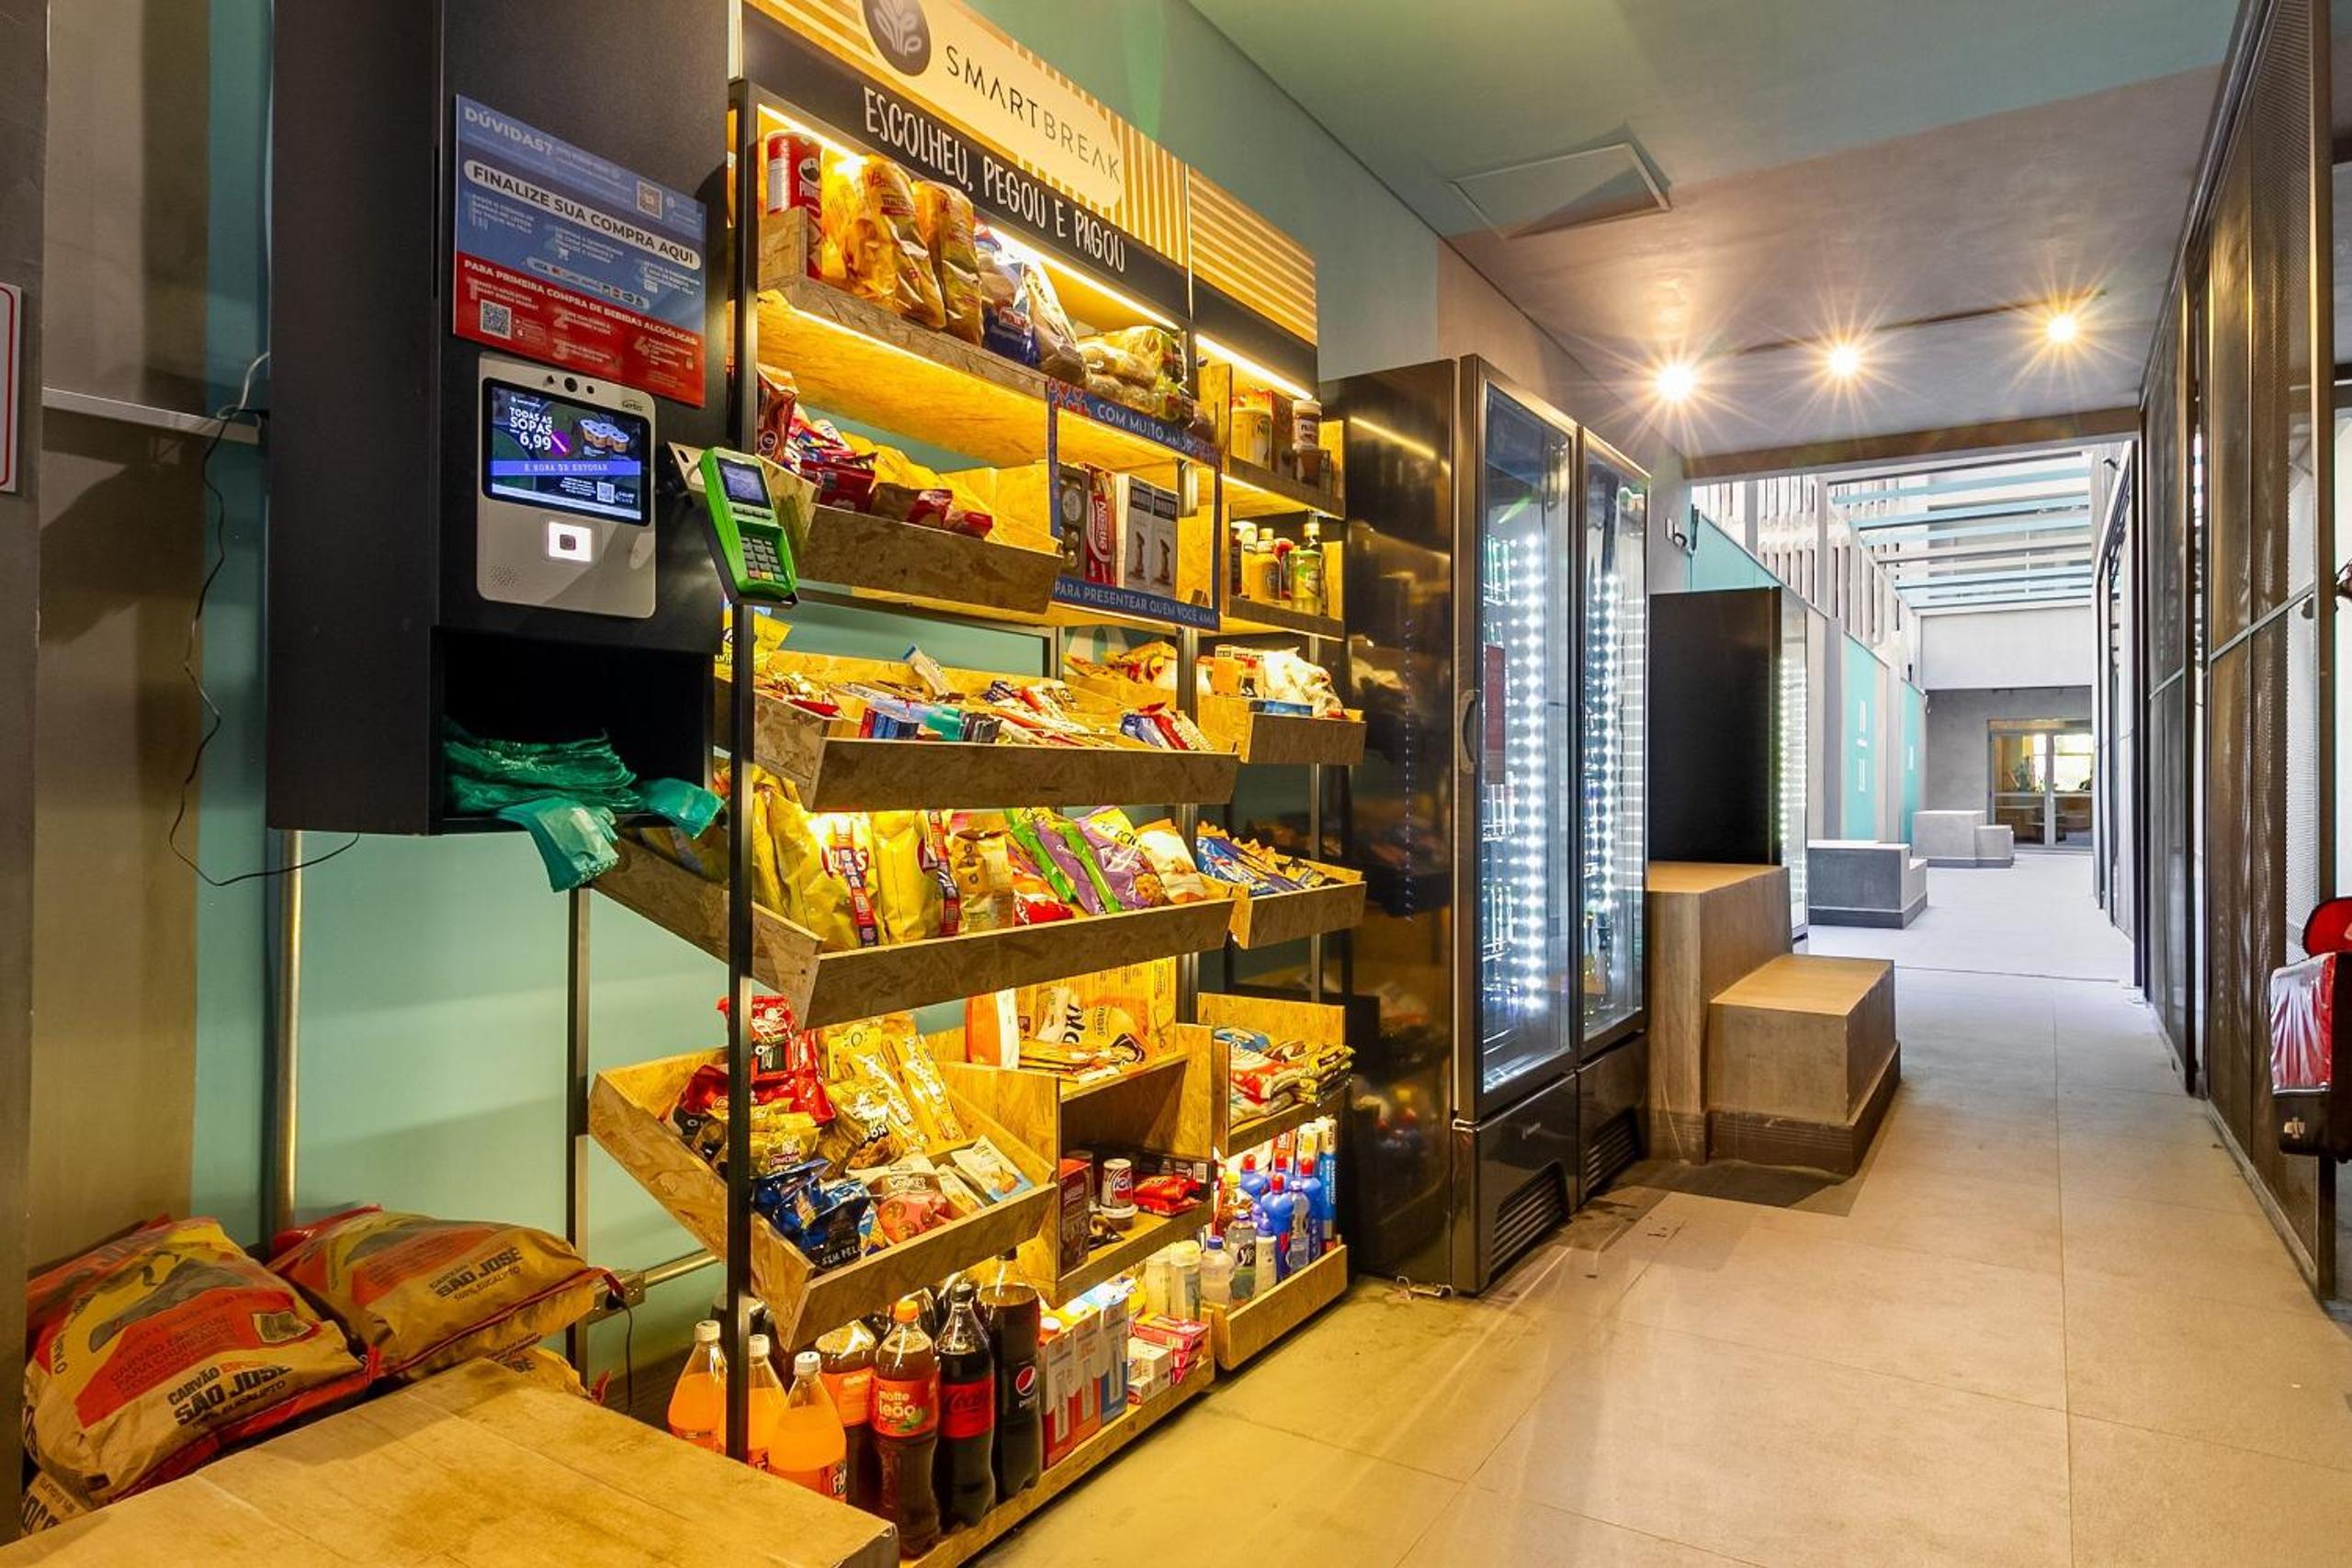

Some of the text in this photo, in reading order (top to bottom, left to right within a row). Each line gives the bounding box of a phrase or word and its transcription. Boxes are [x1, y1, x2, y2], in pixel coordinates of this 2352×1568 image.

[464, 106, 552, 156] DÚVIDAS?
[863, 86, 1125, 274] ESCOLHEU, PEGOU E PAGOU
[473, 165, 550, 208] FINALIZE
[554, 198, 586, 222] SUA
[591, 213, 655, 250] COMPRA
[659, 242, 694, 265] AQUI
[464, 259, 494, 276] PARA
[496, 271, 545, 294] PRIMEIRA
[547, 288, 588, 309] COMPRA
[589, 300, 604, 312] DE
[604, 307, 642, 328] BEBIDAS
[509, 406, 553, 425] TODAS AS
[509, 416, 553, 435] SOPAS
[1097, 403, 1125, 428] COM
[1129, 413, 1164, 440] MUITO
[519, 431, 552, 451] 6,99
[1054, 580, 1081, 599] PARA
[1084, 587, 1149, 610] PRESENTEAR
[167, 1366, 220, 1405] CARVÃO
[878, 1401, 916, 1417] leão
